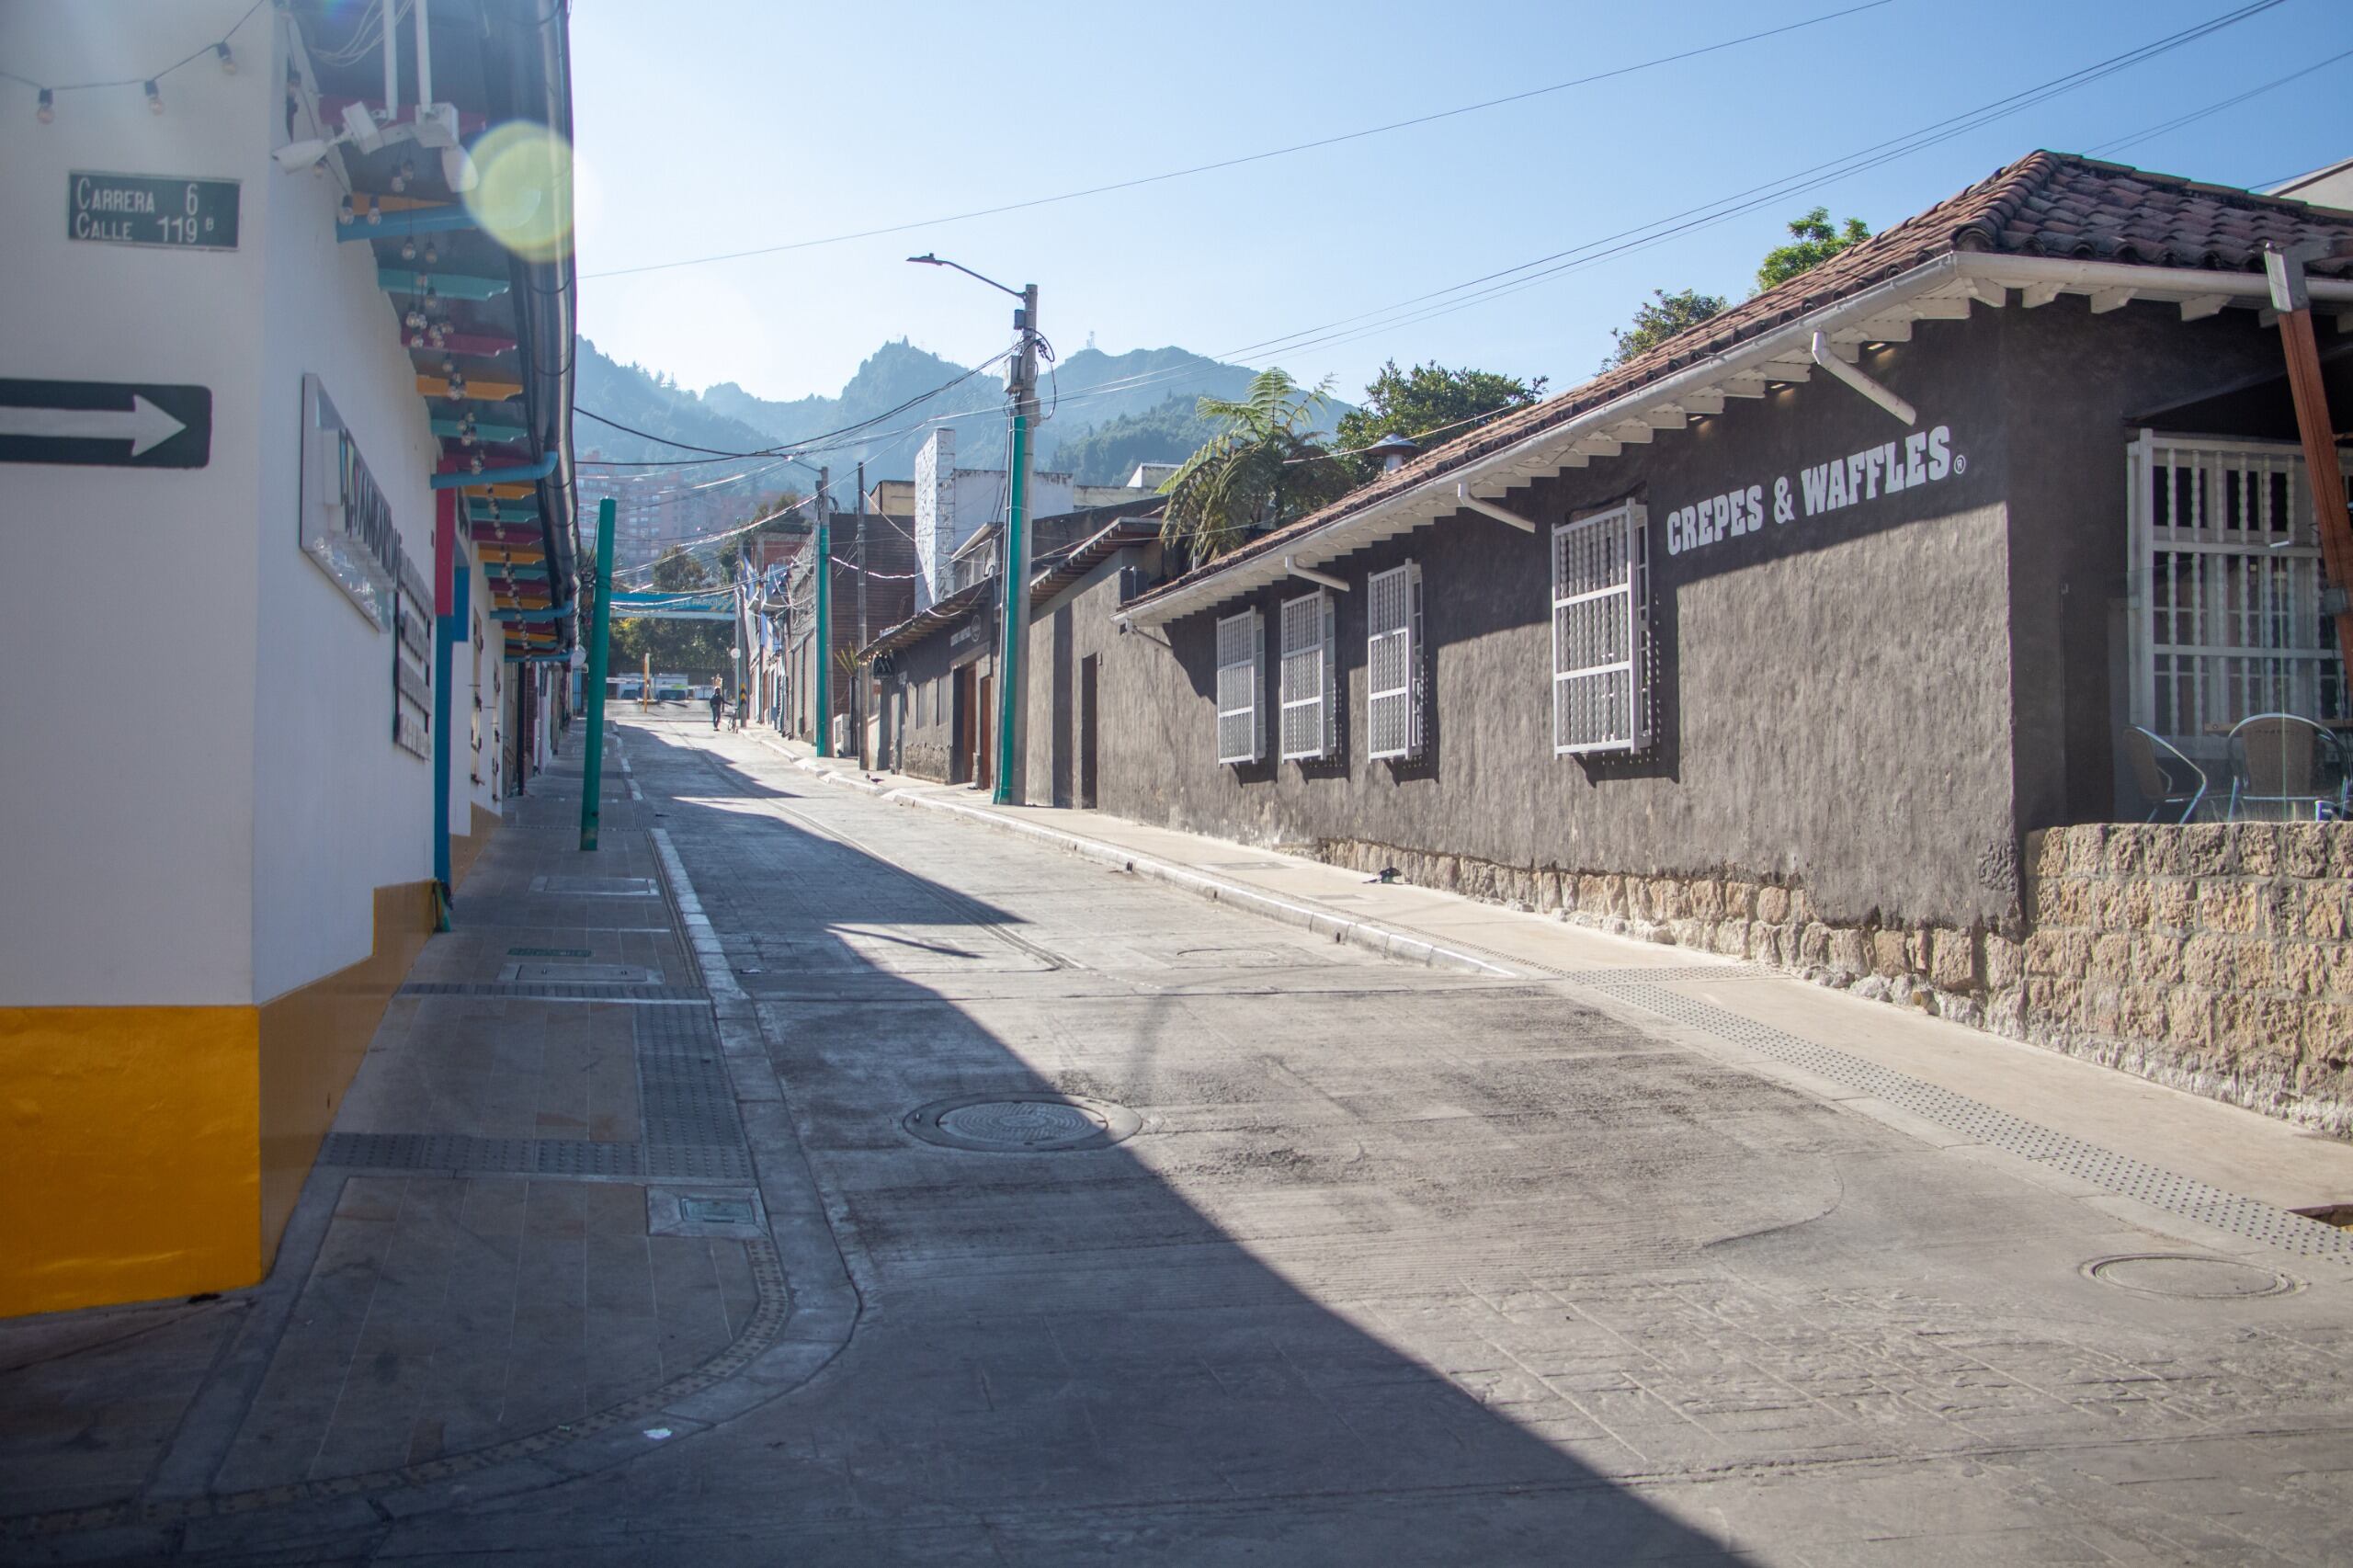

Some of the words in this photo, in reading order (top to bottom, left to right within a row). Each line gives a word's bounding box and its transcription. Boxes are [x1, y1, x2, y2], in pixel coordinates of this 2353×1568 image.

[76, 177, 155, 213] CARRERA
[186, 184, 199, 216] 6
[75, 212, 133, 241] CALLE
[1666, 484, 1763, 555] CREPES
[1773, 476, 1795, 524] &
